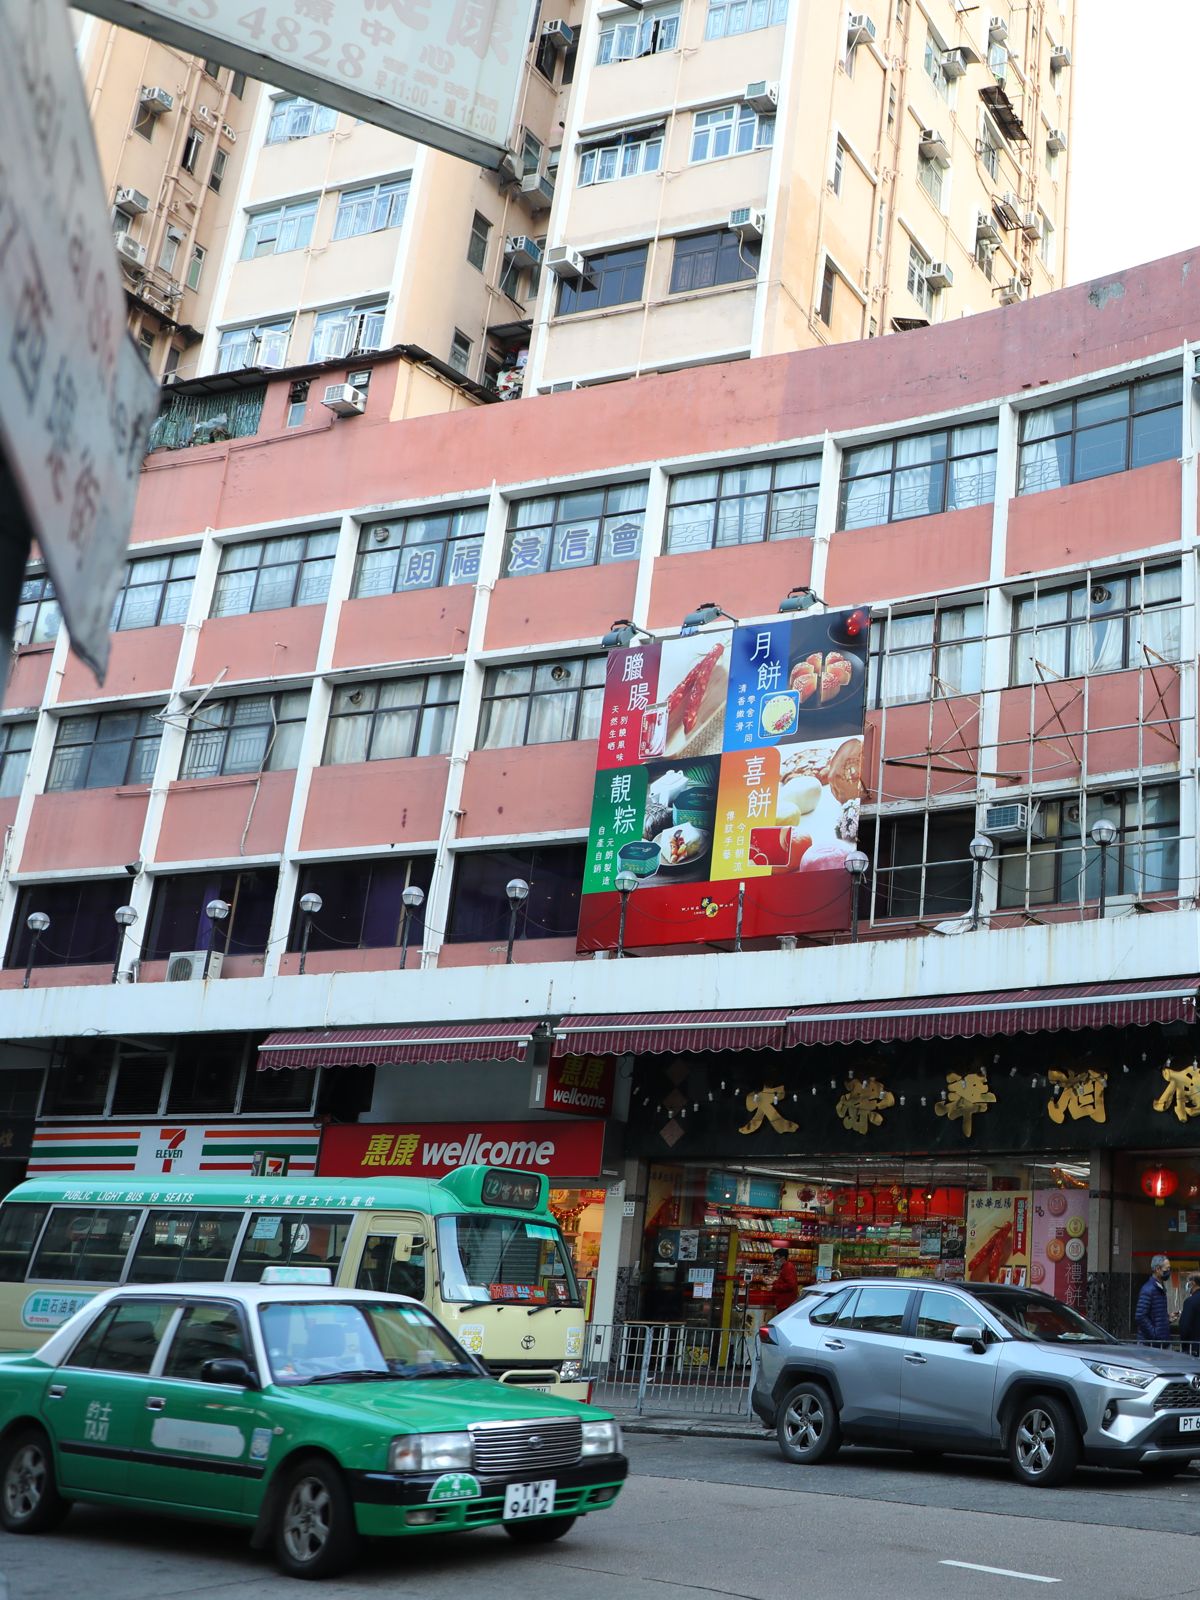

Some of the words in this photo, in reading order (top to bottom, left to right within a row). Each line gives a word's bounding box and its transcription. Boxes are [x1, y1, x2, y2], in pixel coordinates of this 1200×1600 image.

[237, 5, 366, 80] 4828
[750, 631, 781, 690] 月餅
[622, 652, 651, 711] 臘腸
[742, 755, 772, 818] 喜餅
[610, 774, 636, 835] 靚粽
[559, 1056, 605, 1088] 惠康
[553, 1087, 606, 1110] wellcome
[360, 1133, 421, 1166] 惠康
[422, 1133, 555, 1166] wellcome
[62, 1190, 92, 1201] PUBLIC
[97, 1191, 122, 1202] LIGHT
[125, 1191, 143, 1202] BUS
[149, 1192, 160, 1202] 19
[163, 1192, 194, 1203] SEATS
[84, 1420, 108, 1441] TAXI
[1183, 1418, 1193, 1430] PT
[438, 1489, 473, 1499] SEATS
[510, 1498, 549, 1517] 9412
